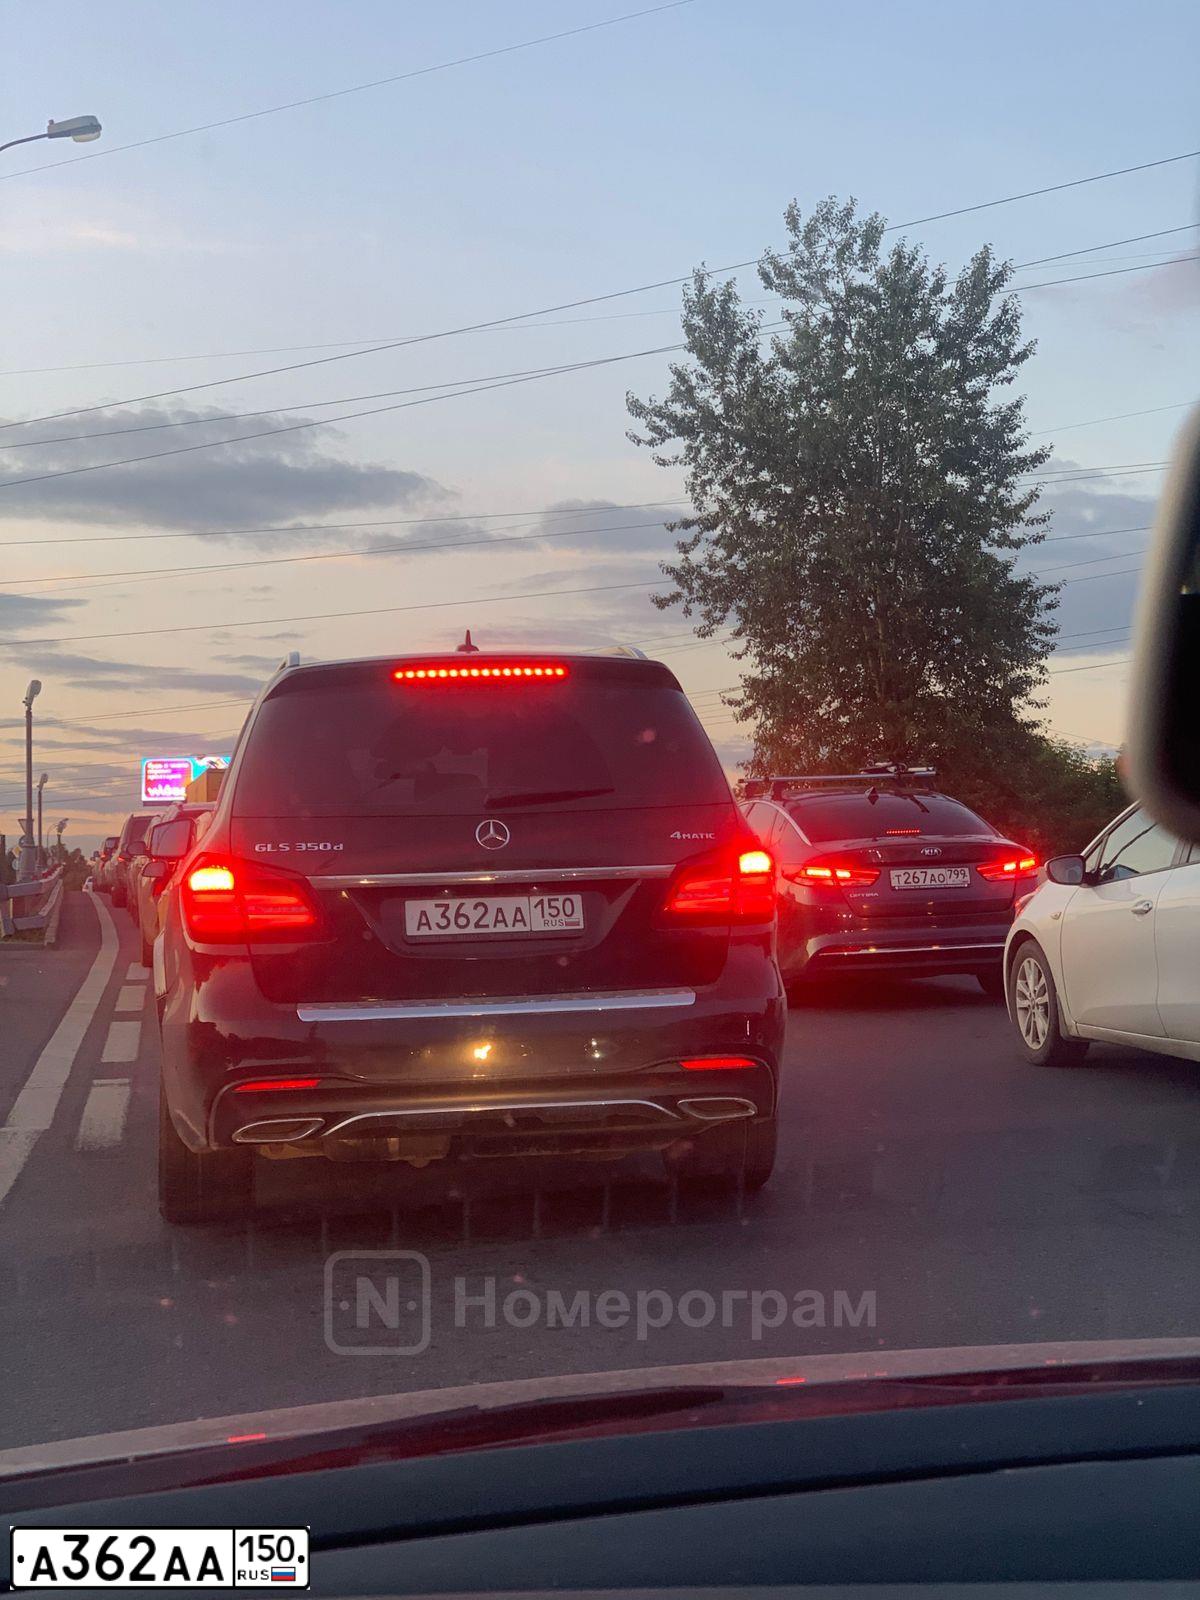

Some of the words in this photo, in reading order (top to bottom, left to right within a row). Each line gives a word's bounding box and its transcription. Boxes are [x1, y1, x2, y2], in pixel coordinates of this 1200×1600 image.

[670, 831, 716, 840] 4MATIC
[254, 842, 290, 852] GLS
[295, 841, 344, 851] 350d
[946, 868, 966, 880] 799
[416, 901, 527, 931] А362АА
[533, 897, 575, 919] 150
[543, 918, 564, 927] RUS
